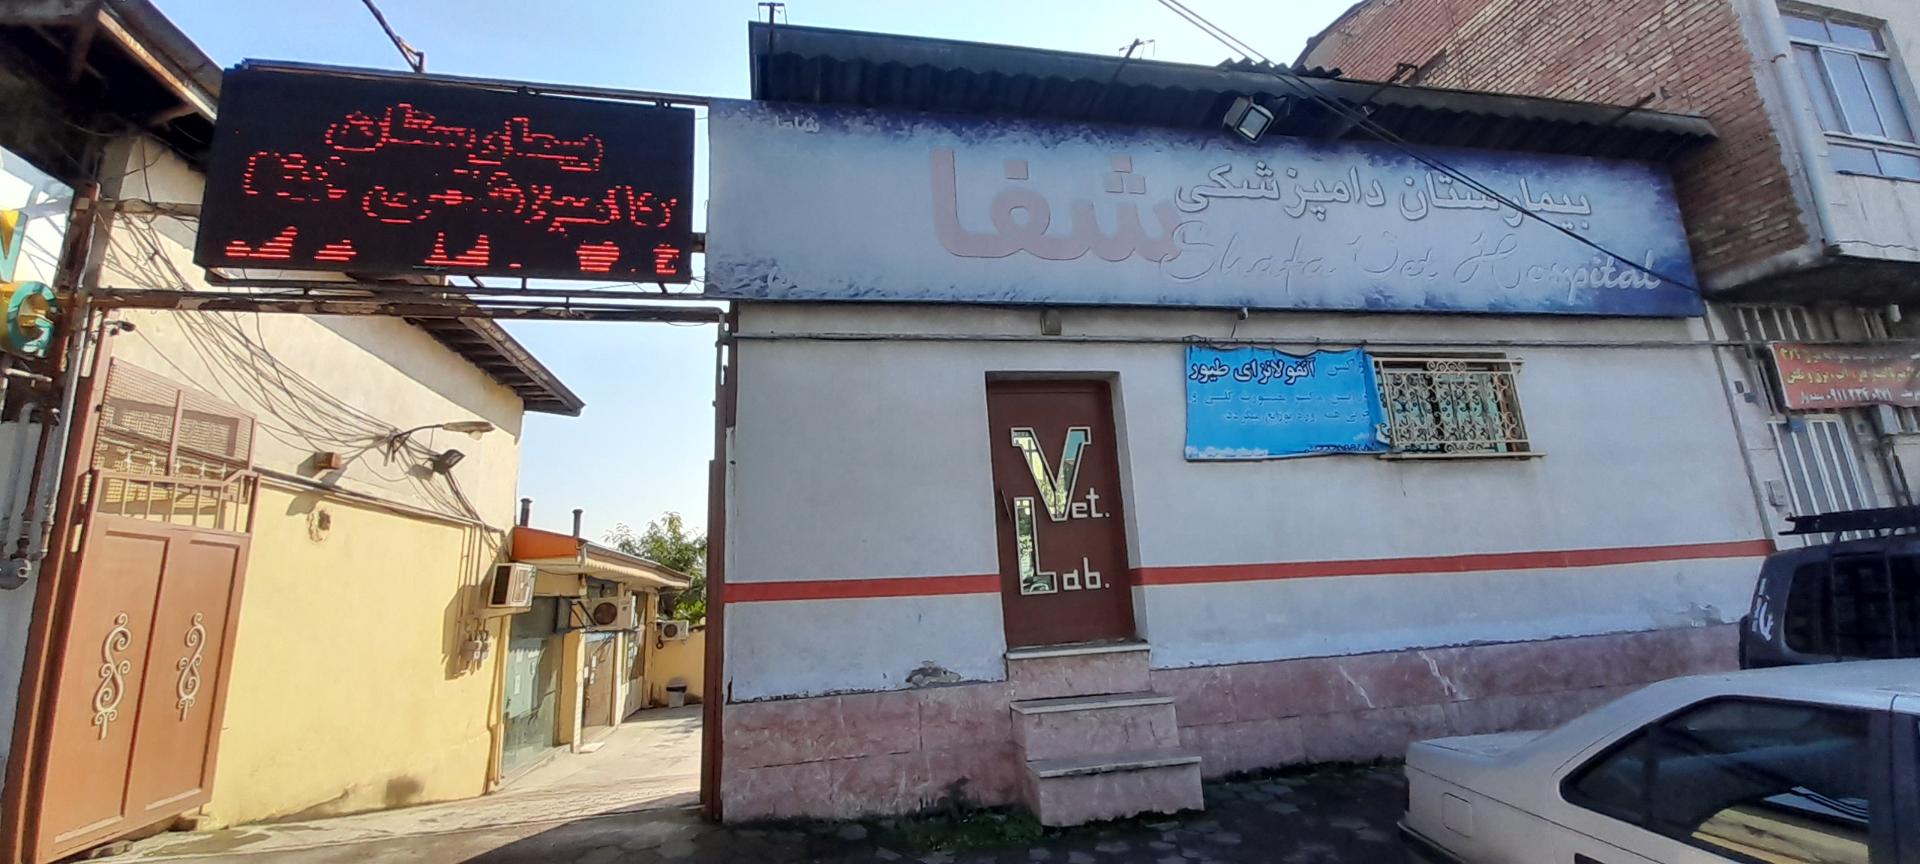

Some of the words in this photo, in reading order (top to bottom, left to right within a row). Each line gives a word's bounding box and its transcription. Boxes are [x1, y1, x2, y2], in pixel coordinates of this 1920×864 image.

[930, 147, 1184, 263] شفا
[1174, 159, 1388, 222] دامپزشکی
[1400, 171, 1594, 231] بیمارستان
[1188, 358, 1231, 384] طیور
[1233, 357, 1317, 385] آنفولانزای
[1011, 426, 1110, 522] Vet.
[1013, 496, 1110, 596] Lab.
